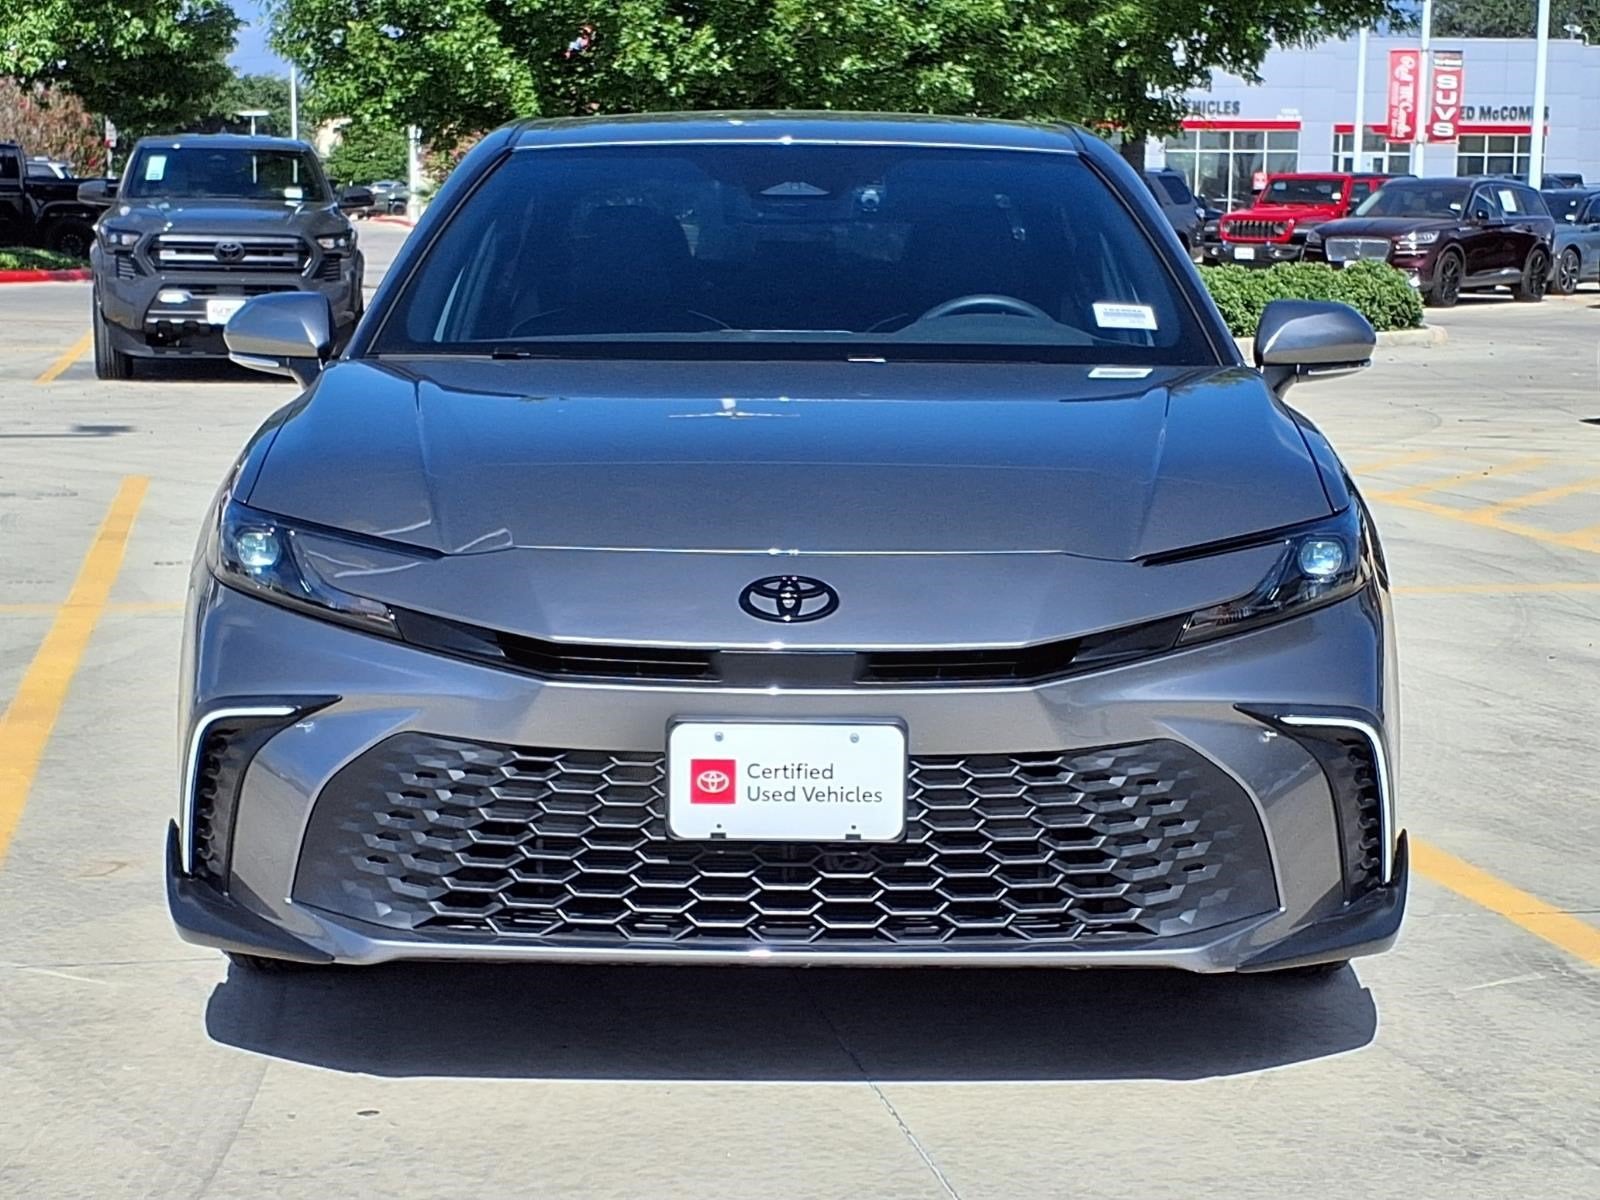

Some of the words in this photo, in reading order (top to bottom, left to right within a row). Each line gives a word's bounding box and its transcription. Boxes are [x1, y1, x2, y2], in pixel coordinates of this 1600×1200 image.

[1432, 74, 1458, 137] SUVS
[747, 763, 834, 780] Certified
[746, 786, 796, 802] Used
[802, 786, 883, 803] Vehicles
